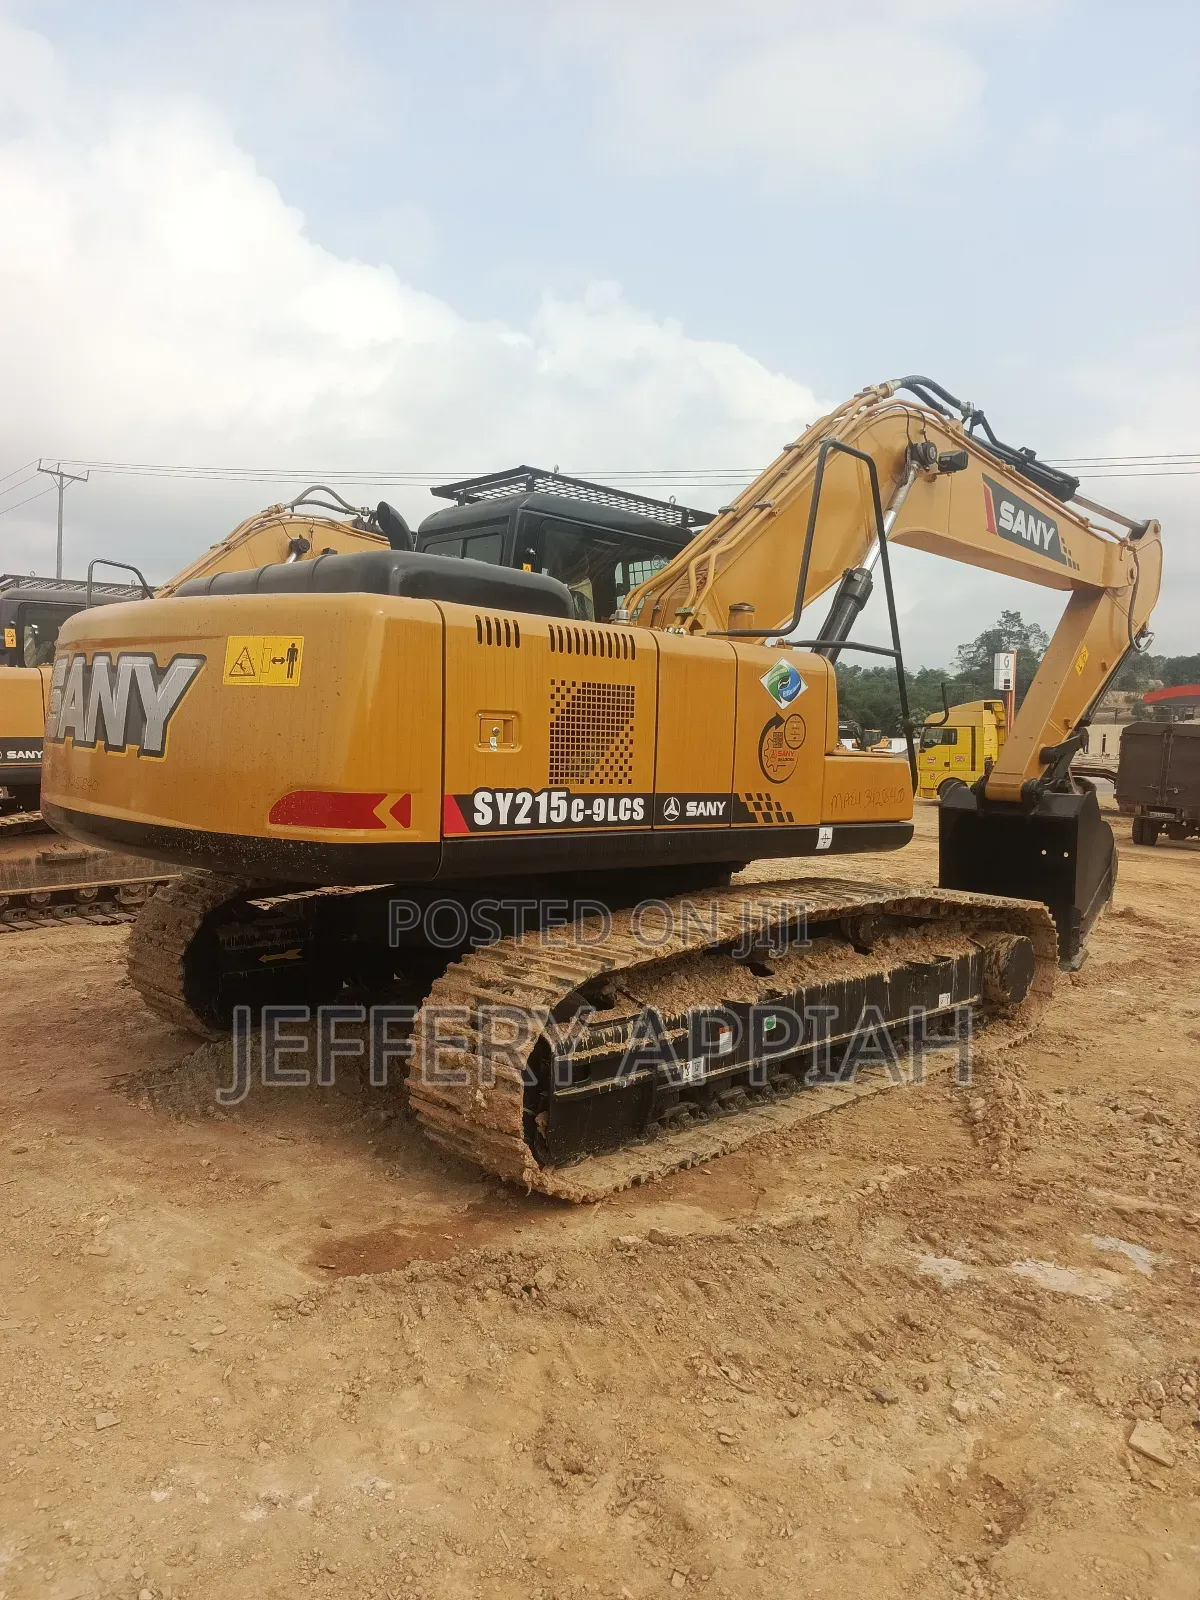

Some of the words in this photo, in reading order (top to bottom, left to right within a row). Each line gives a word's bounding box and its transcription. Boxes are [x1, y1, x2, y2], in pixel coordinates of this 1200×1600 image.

[998, 500, 1056, 551] SANY
[6, 750, 44, 759] SANY
[777, 750, 796, 758] SANY
[685, 801, 727, 817] SANY
